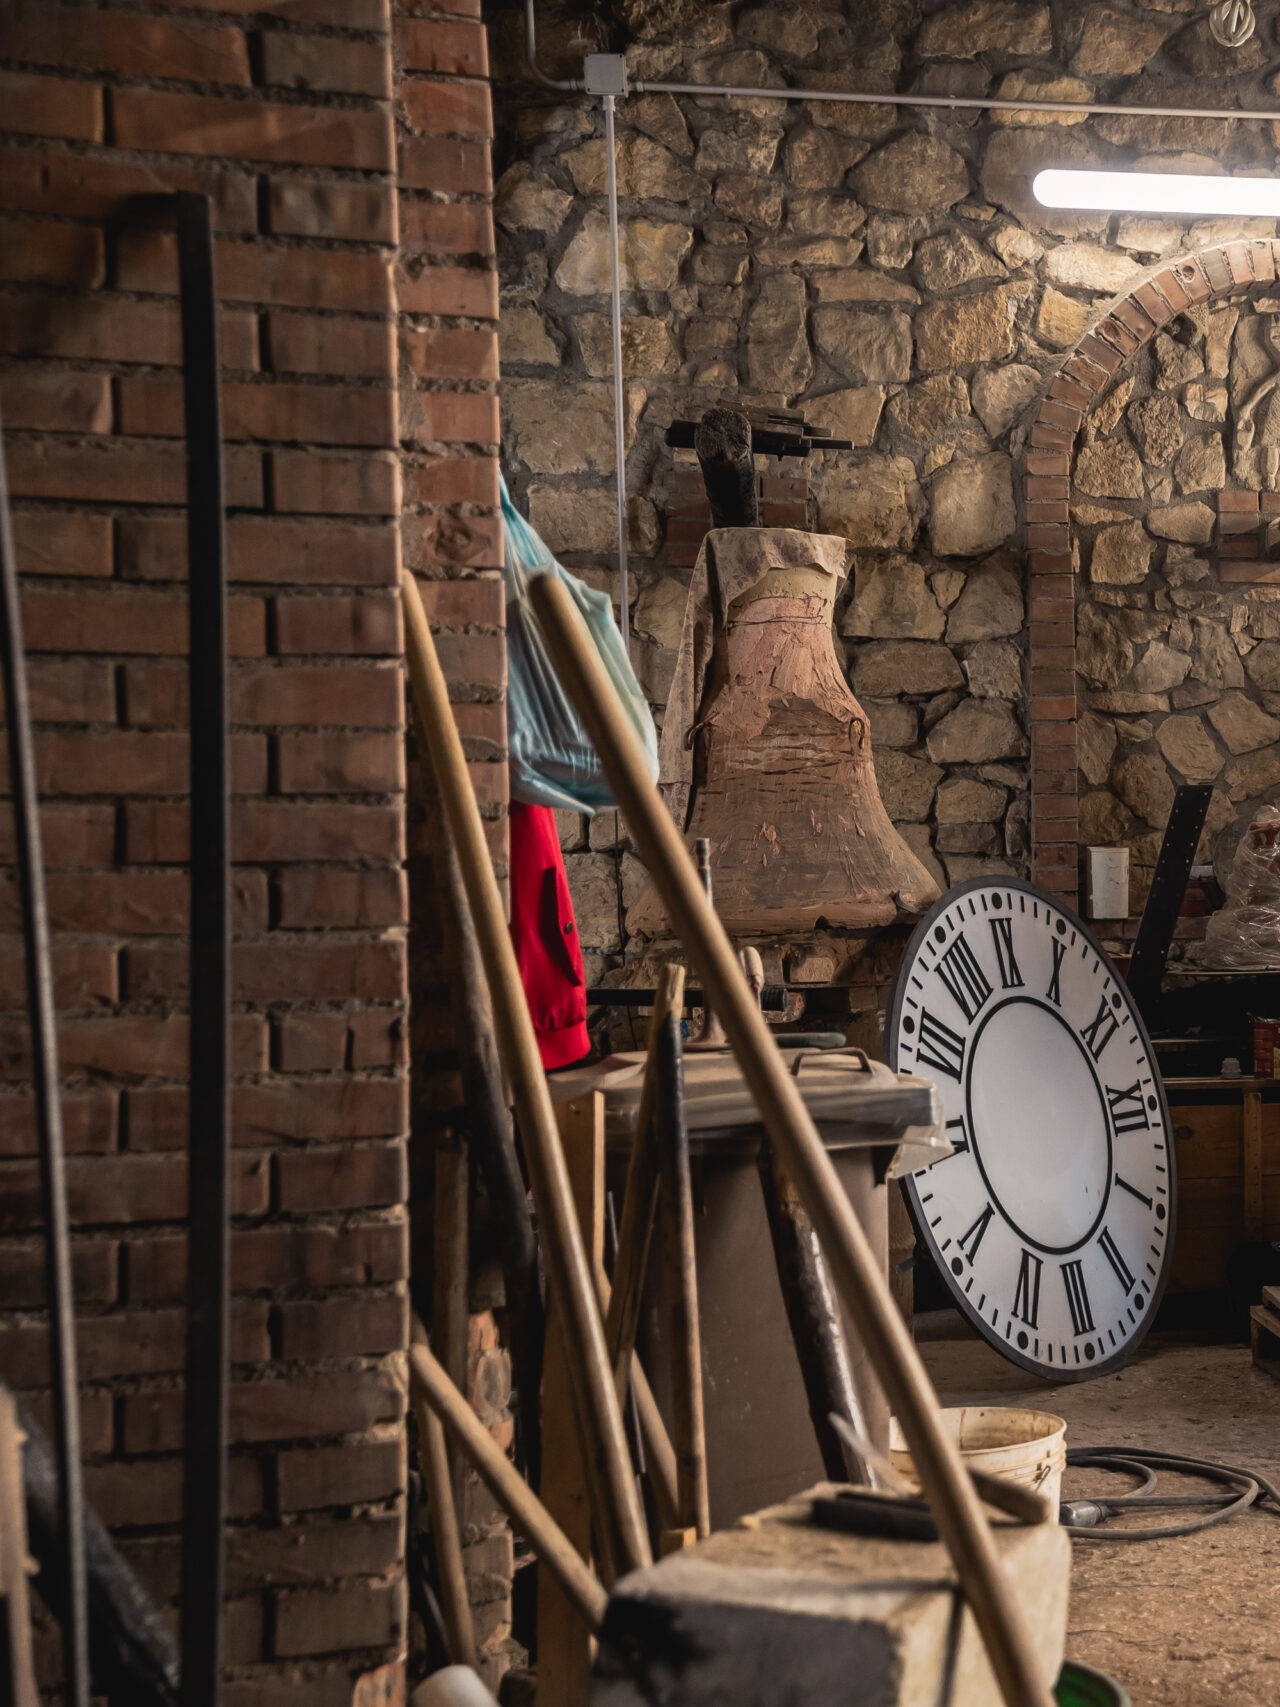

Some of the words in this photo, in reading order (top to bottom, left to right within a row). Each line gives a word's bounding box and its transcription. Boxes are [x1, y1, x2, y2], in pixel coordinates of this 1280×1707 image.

[934, 931, 994, 1025] VIII
[988, 917, 1025, 989] IX
[1045, 936, 1067, 1007] X
[915, 1006, 966, 1084] VII
[1079, 995, 1120, 1064] XI
[1105, 1079, 1150, 1137] XII
[1114, 1173, 1153, 1210] I
[957, 1201, 995, 1267] V
[1097, 1225, 1136, 1296] II
[1011, 1248, 1043, 1330] IV
[1059, 1259, 1096, 1336] III
